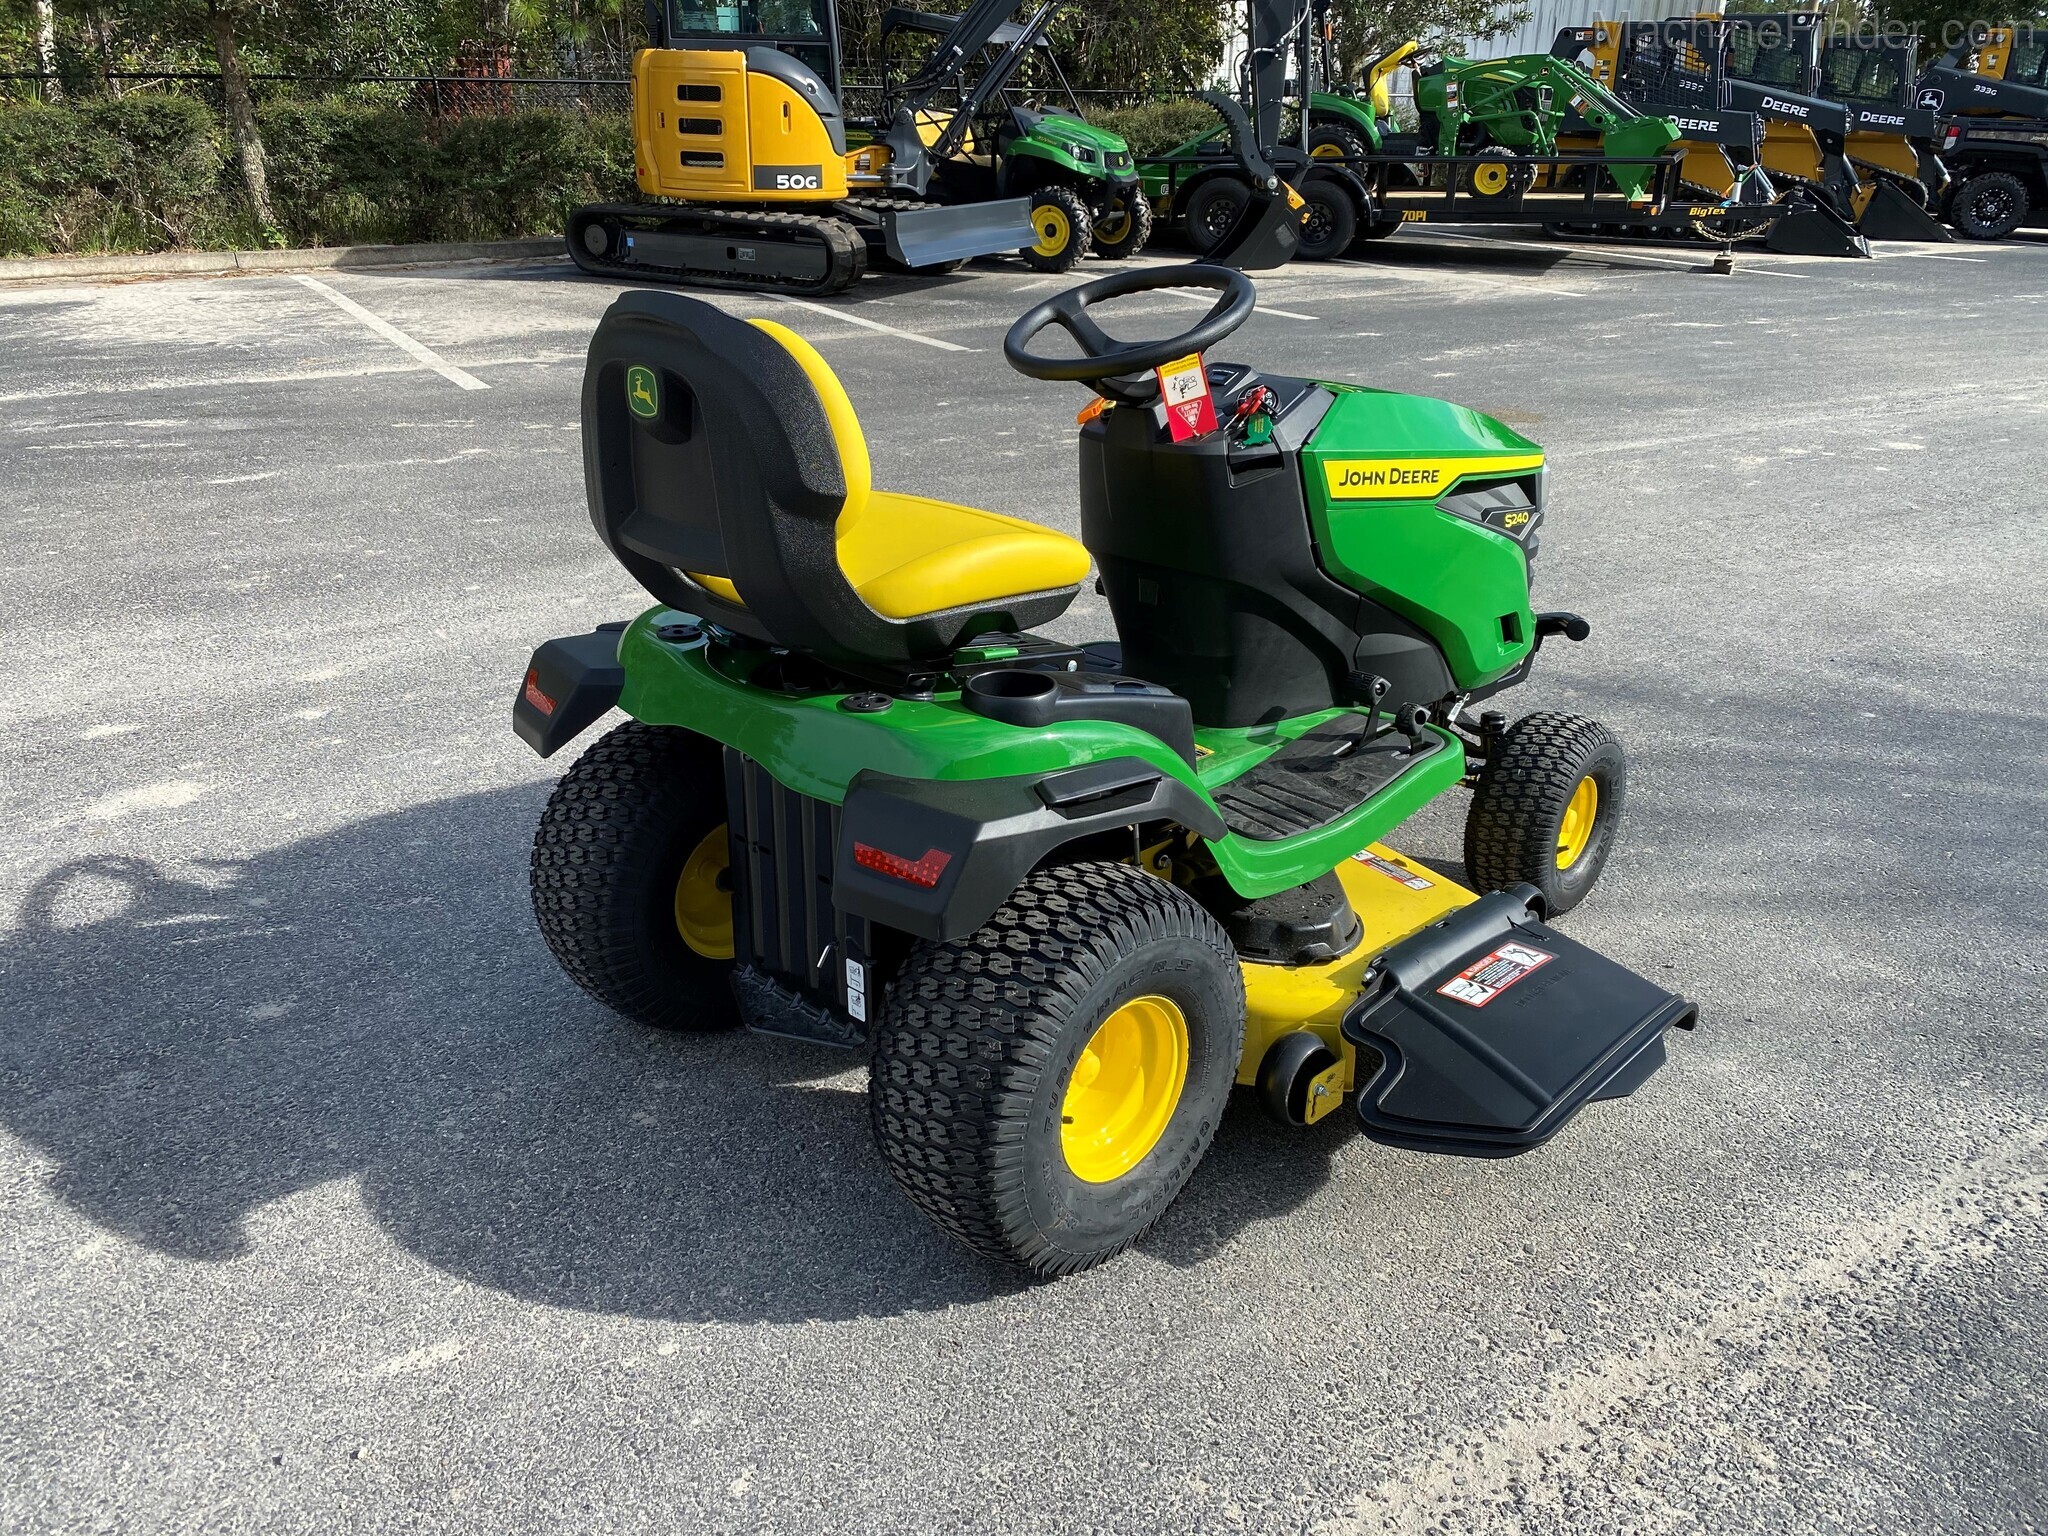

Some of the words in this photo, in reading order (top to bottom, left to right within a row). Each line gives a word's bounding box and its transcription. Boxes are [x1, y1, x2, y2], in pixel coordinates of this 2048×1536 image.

[1973, 84, 1998, 96] 333G
[1761, 96, 1810, 117] DEERE
[1668, 115, 1720, 132] DEERE
[1860, 111, 1905, 126] DEERE
[777, 174, 817, 189] 50G
[1402, 210, 1427, 221] 70PI
[1339, 469, 1386, 486] JOHN
[1389, 467, 1440, 485] DEERE
[1505, 512, 1529, 528] S240
